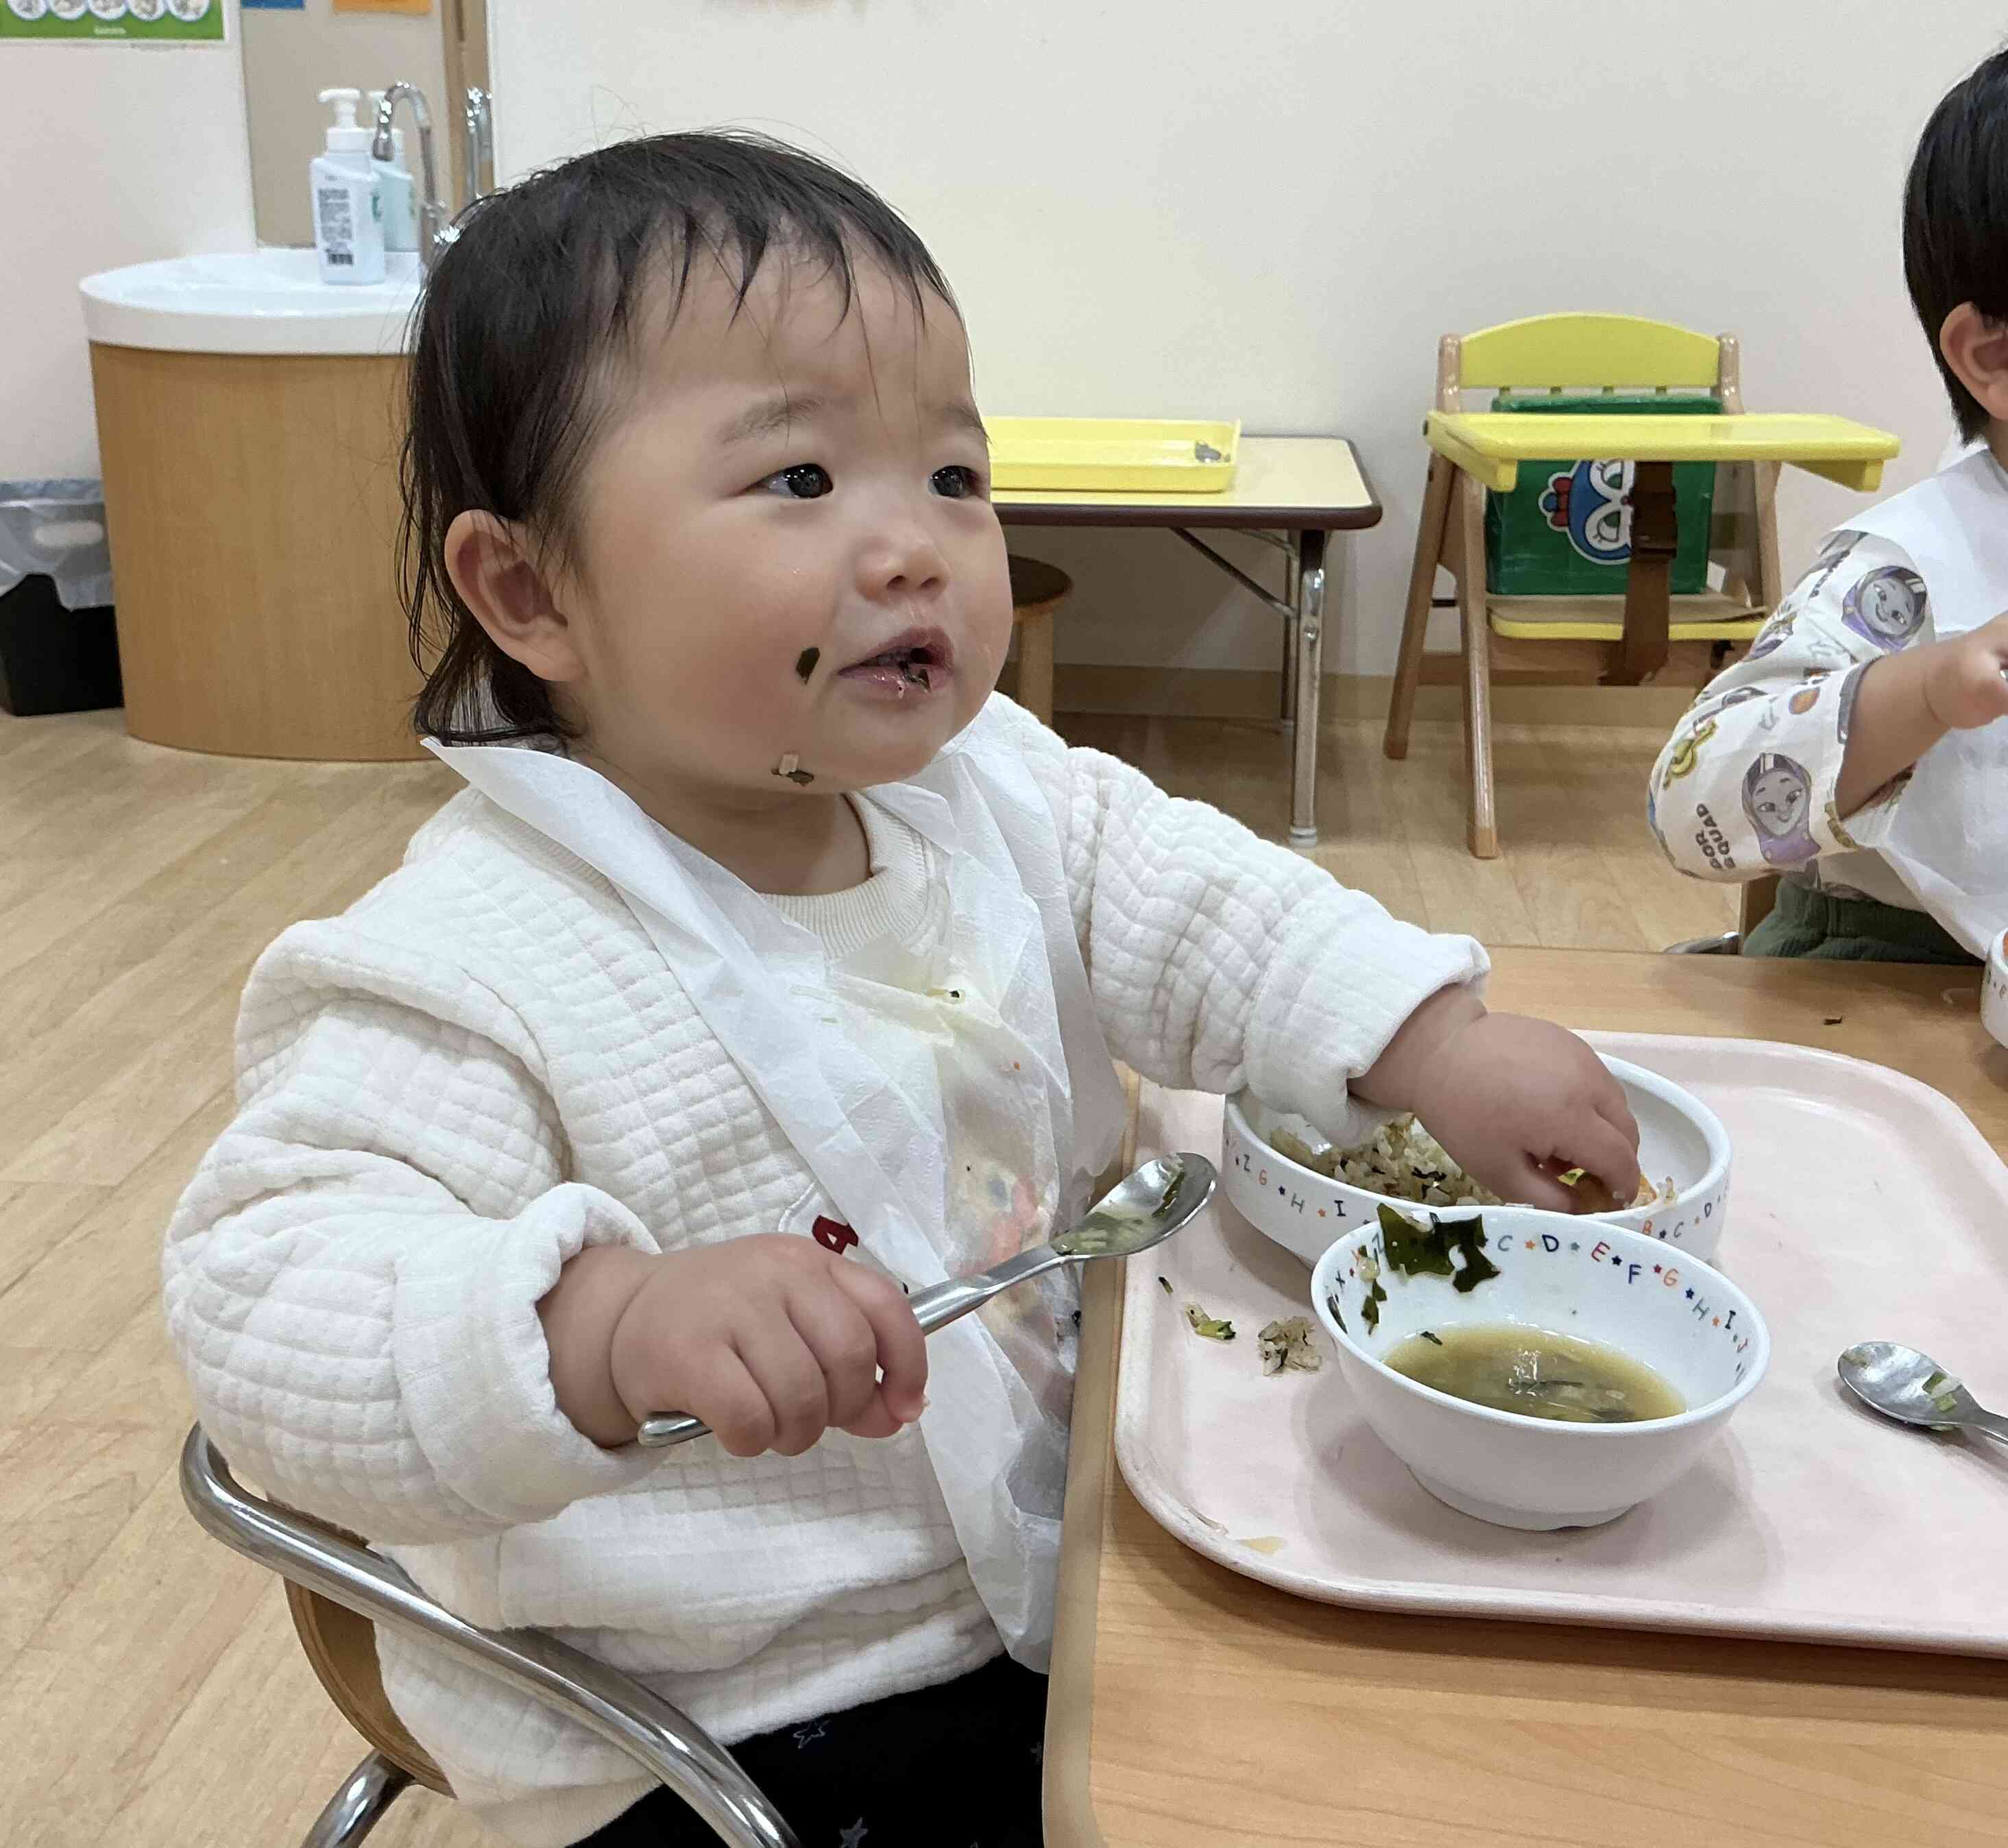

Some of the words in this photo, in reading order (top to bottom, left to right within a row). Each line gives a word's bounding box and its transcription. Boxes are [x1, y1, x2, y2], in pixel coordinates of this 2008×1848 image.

[1290, 1193, 1305, 1213] H
[1334, 1200, 1346, 1217] I
[1497, 1235, 1514, 1252] C
[1542, 1234, 1560, 1253] D
[1590, 1241, 1611, 1263] E
[1628, 1263, 1643, 1285] F
[1663, 1268, 1679, 1287] G
[1692, 1297, 1710, 1321] H
[1724, 1309, 1737, 1330] I
